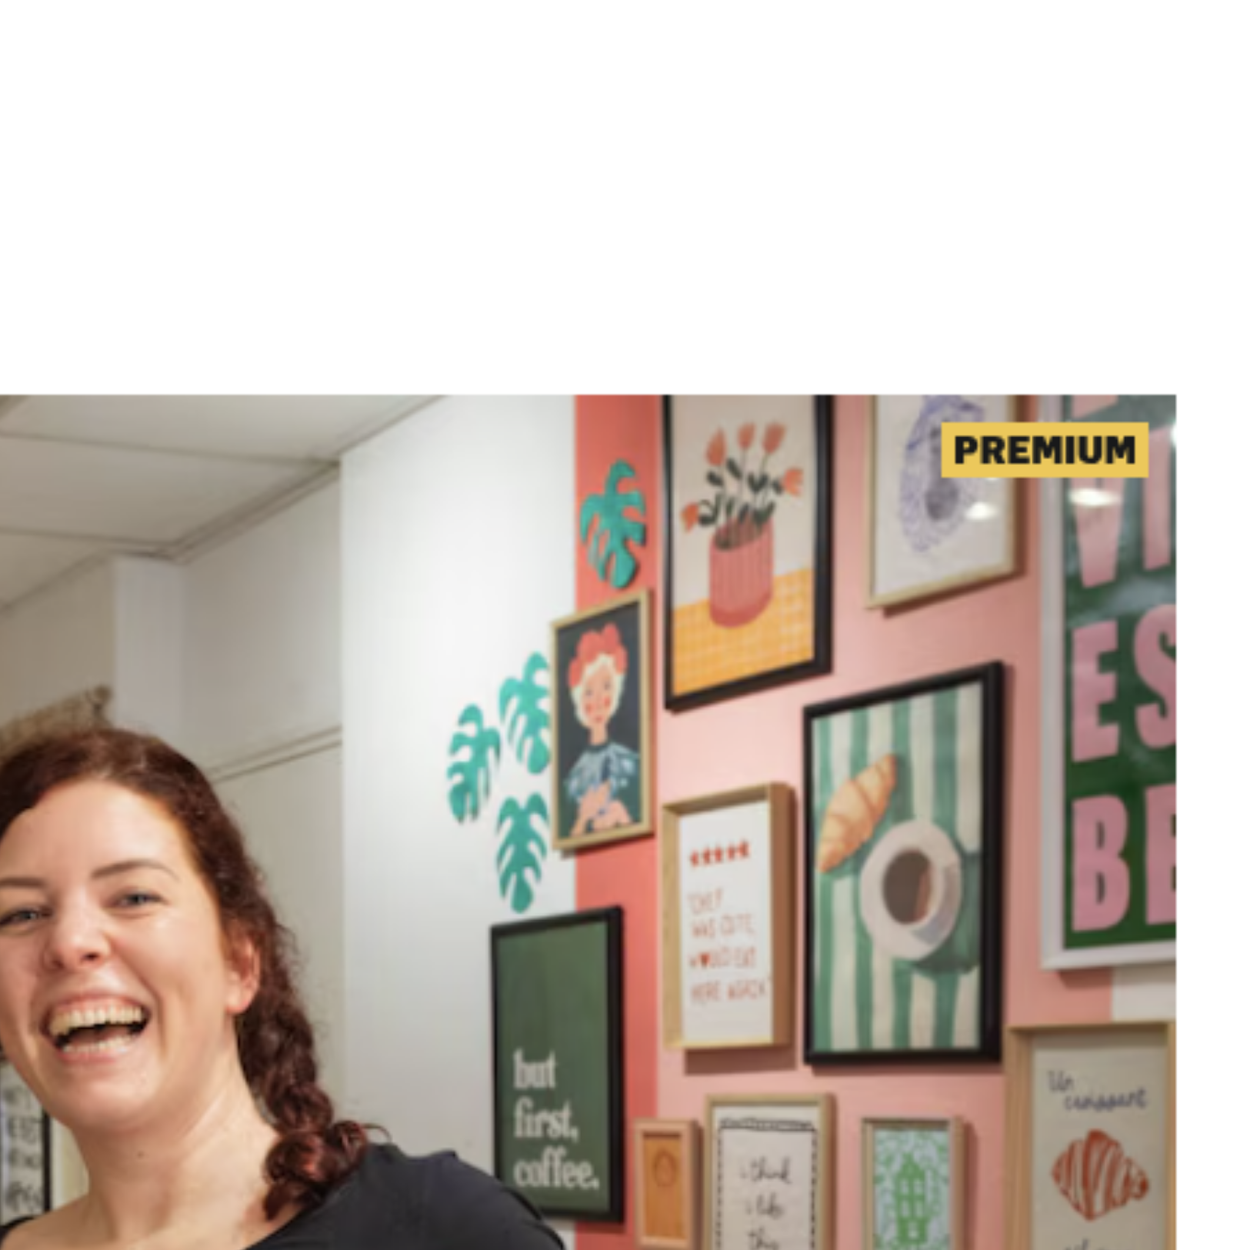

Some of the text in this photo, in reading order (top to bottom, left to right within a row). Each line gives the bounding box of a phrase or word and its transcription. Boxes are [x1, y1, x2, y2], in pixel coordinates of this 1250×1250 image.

[514, 1048, 557, 1088] but
[514, 1097, 580, 1142] first,
[514, 1146, 600, 1189] coffee.
[751, 1156, 793, 1184] think
